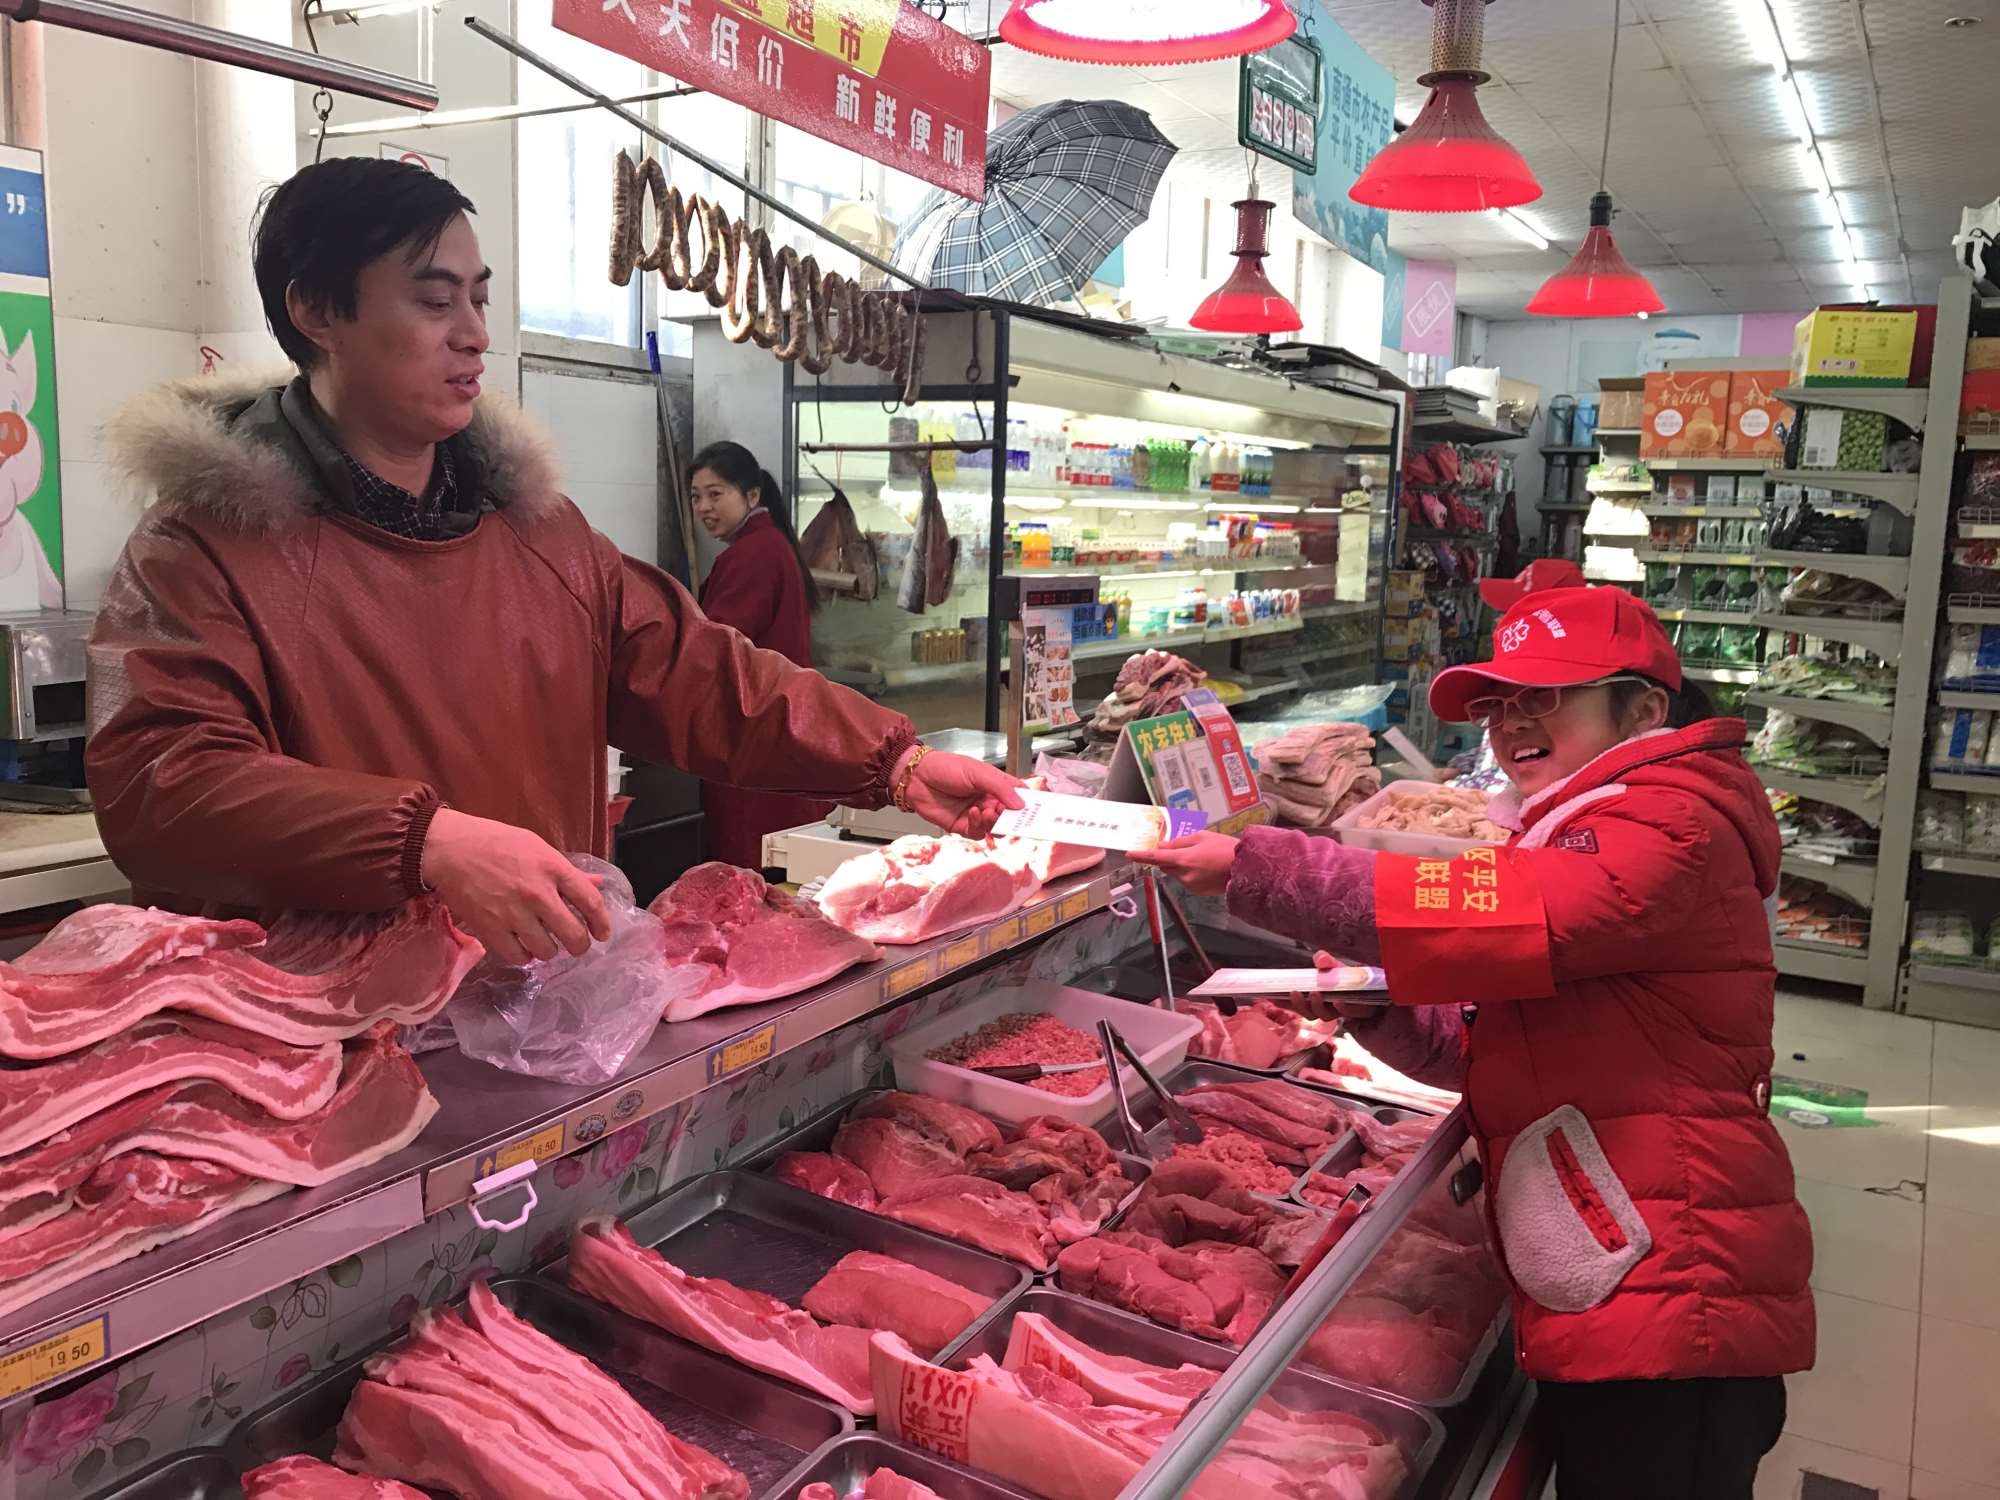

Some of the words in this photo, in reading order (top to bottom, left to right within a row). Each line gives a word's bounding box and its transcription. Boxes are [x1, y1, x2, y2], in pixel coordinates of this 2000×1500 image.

[745, 0, 864, 62] 超市
[836, 73, 964, 169] 新鲜便利
[1415, 857, 1451, 910] 联盟
[1462, 847, 1499, 912] 区平安
